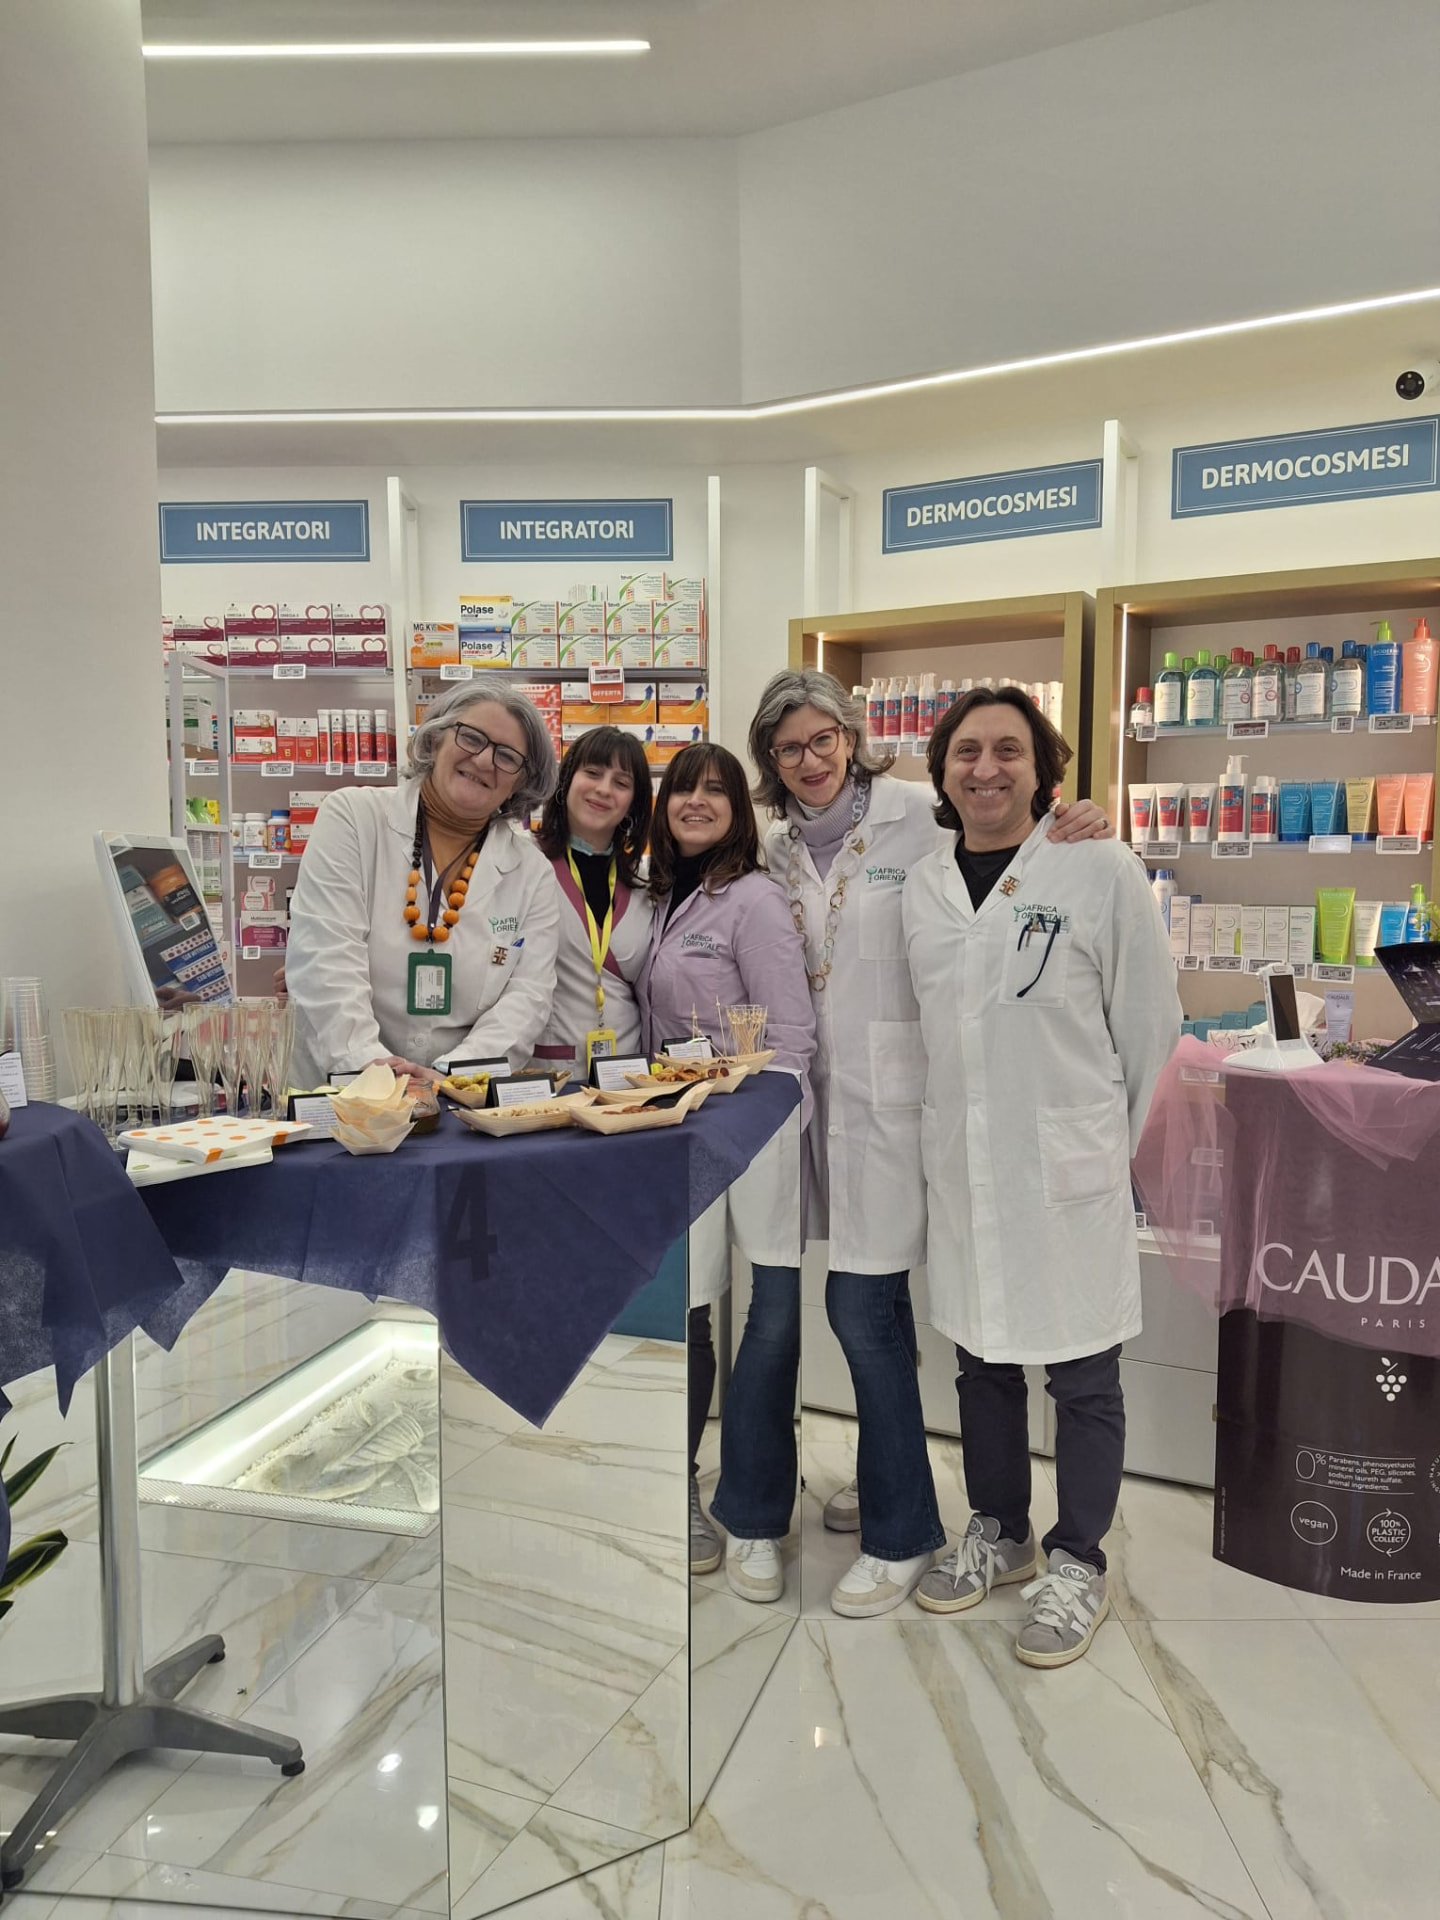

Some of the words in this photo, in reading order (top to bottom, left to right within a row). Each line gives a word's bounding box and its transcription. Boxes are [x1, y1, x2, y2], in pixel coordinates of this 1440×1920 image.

[1202, 444, 1409, 489] DERMOCOSMESI
[907, 485, 1077, 527] DERMOCOSMESI
[196, 521, 330, 541] INTEGRATORI
[500, 520, 634, 540] INTEGRATORI
[461, 605, 494, 614] Polase
[461, 642, 493, 650] Polase
[878, 867, 906, 875] AFRICA
[1026, 904, 1058, 913] AFRICA
[1361, 1317, 1426, 1329] PARIS
[1328, 1464, 1354, 1473] mineral
[1328, 1471, 1354, 1480] sodium
[1327, 1479, 1351, 1488] animal
[1298, 1516, 1329, 1530] vegan
[1380, 1519, 1402, 1528] 100%
[1371, 1527, 1407, 1536] PLASTIC
[1372, 1535, 1405, 1543] COLLECT
[1340, 1565, 1372, 1579] Made
[1375, 1569, 1385, 1580] in
[1387, 1569, 1422, 1581] France
